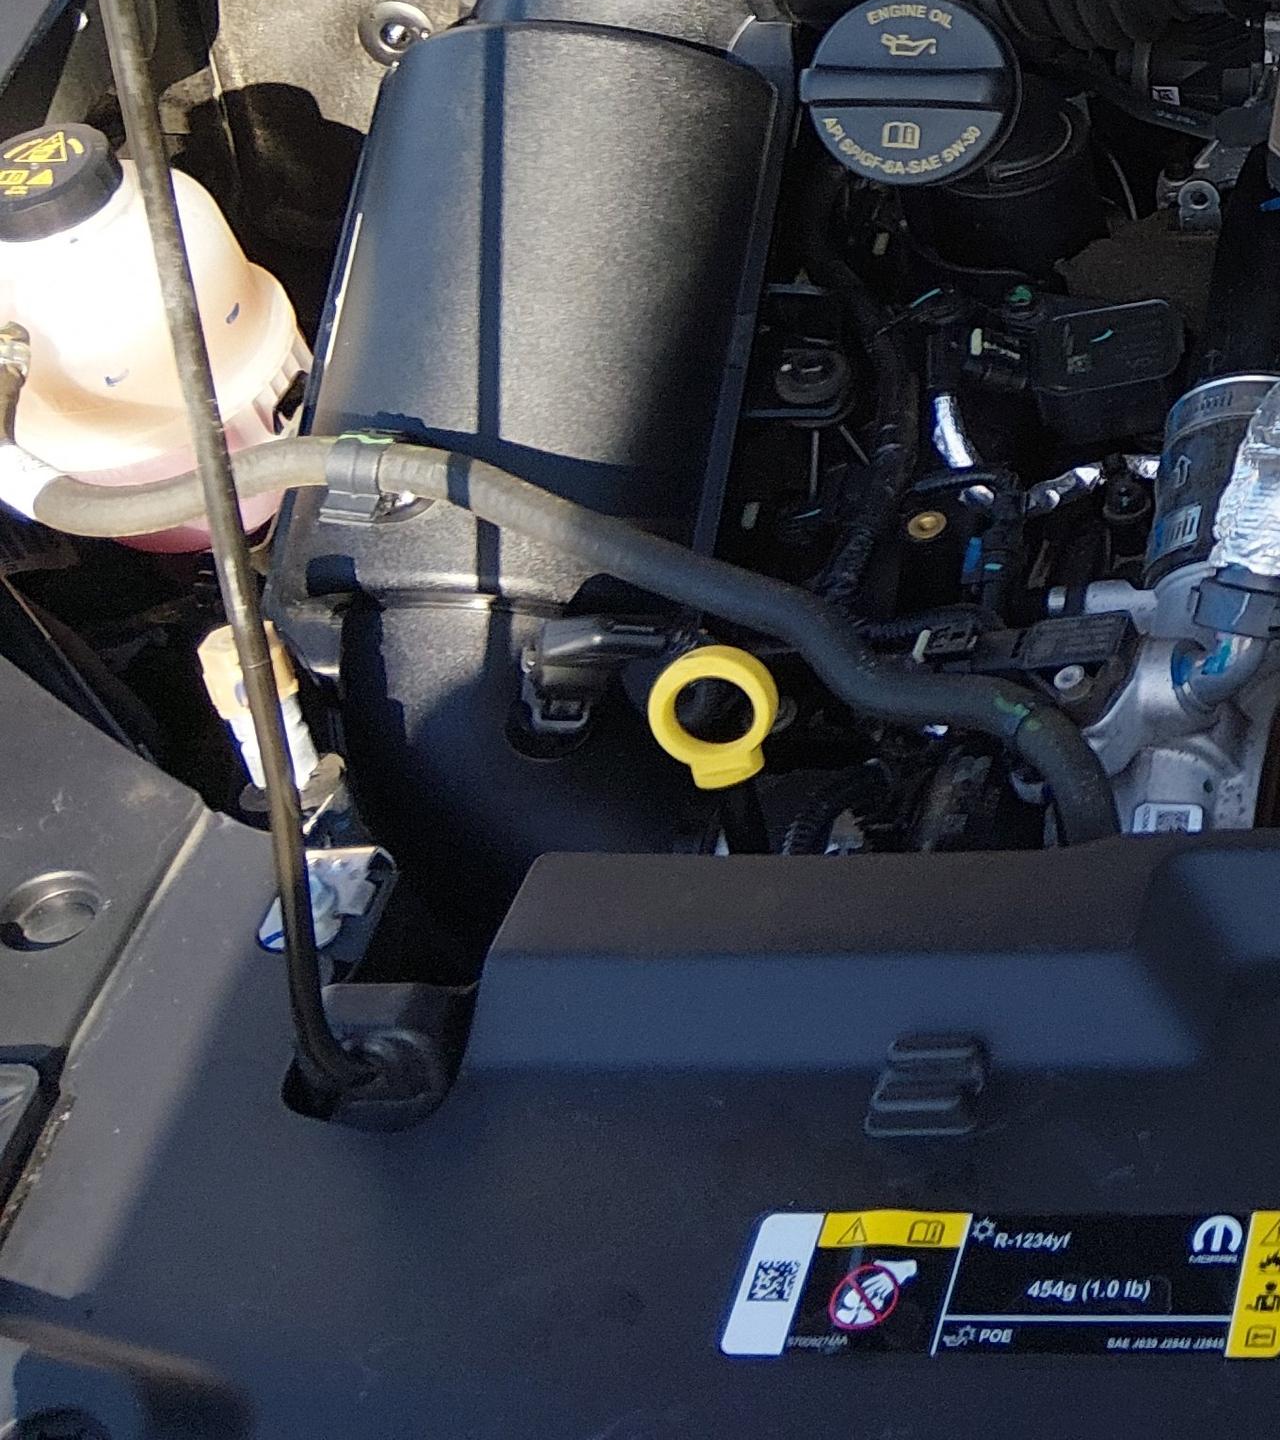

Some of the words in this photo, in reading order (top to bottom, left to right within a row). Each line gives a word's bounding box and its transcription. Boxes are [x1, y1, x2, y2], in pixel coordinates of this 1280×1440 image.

[866, 4, 927, 25] ENGINE
[928, 7, 953, 30] OIL
[821, 118, 846, 142] API
[993, 1231, 1073, 1252] R-1234yf
[1027, 1279, 1078, 1302] 454g
[1081, 1279, 1120, 1302] (1.0
[1123, 1279, 1151, 1302] lb)
[979, 1328, 1013, 1344] POE
